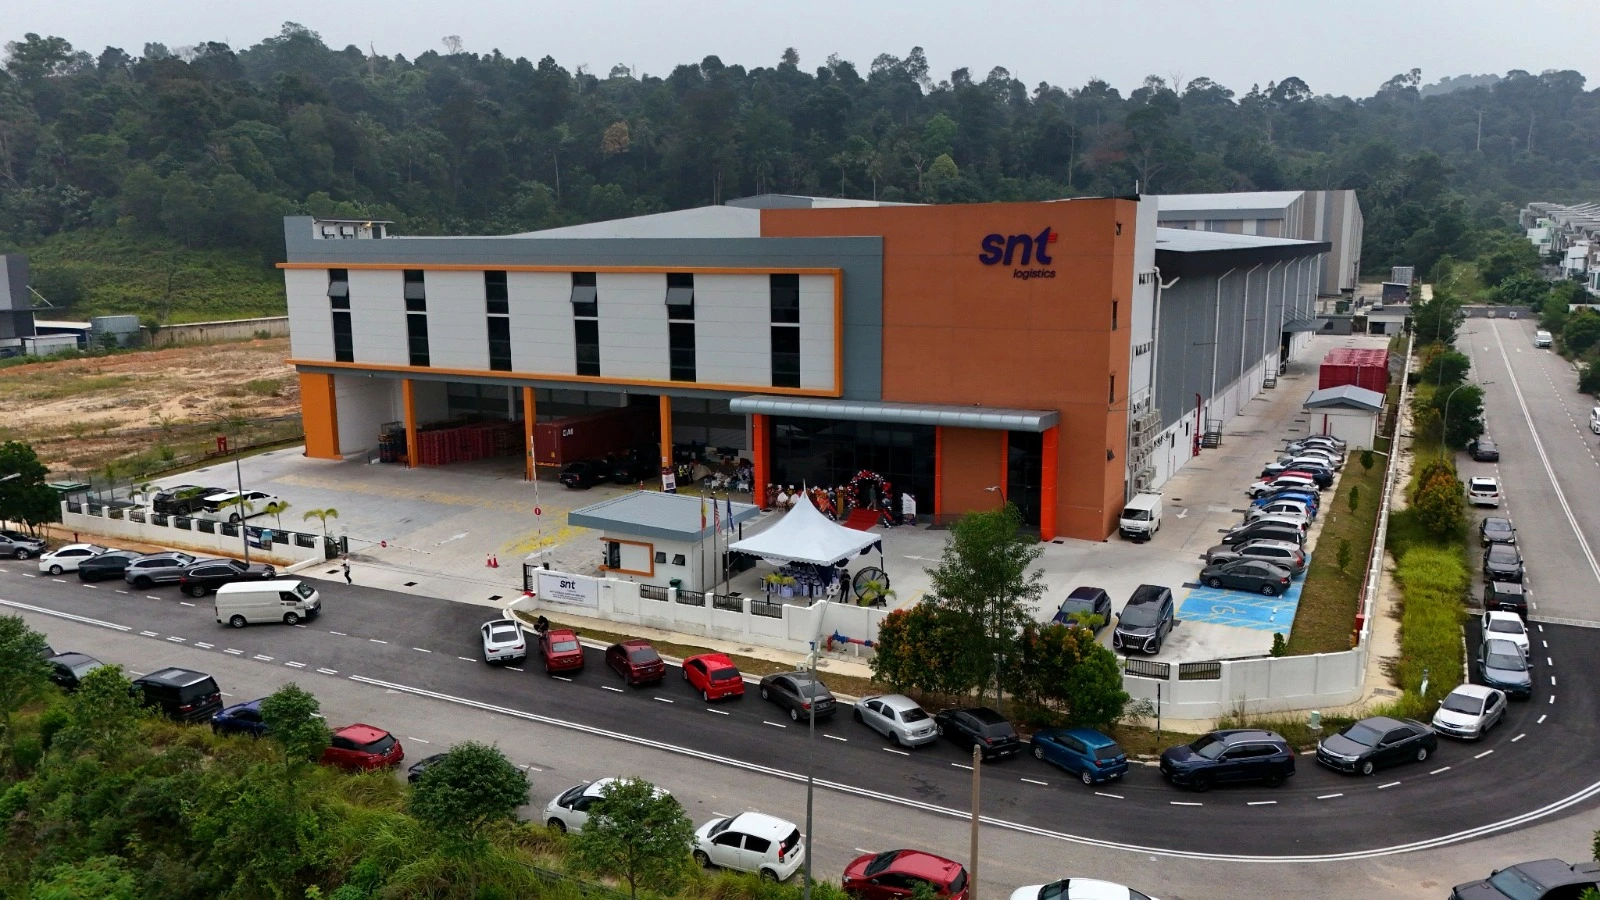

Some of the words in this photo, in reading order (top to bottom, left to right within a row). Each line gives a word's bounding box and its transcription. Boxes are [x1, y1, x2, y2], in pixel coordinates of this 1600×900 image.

[979, 226, 1057, 266] snt
[1013, 268, 1056, 280] logistics
[560, 580, 575, 589] snt
